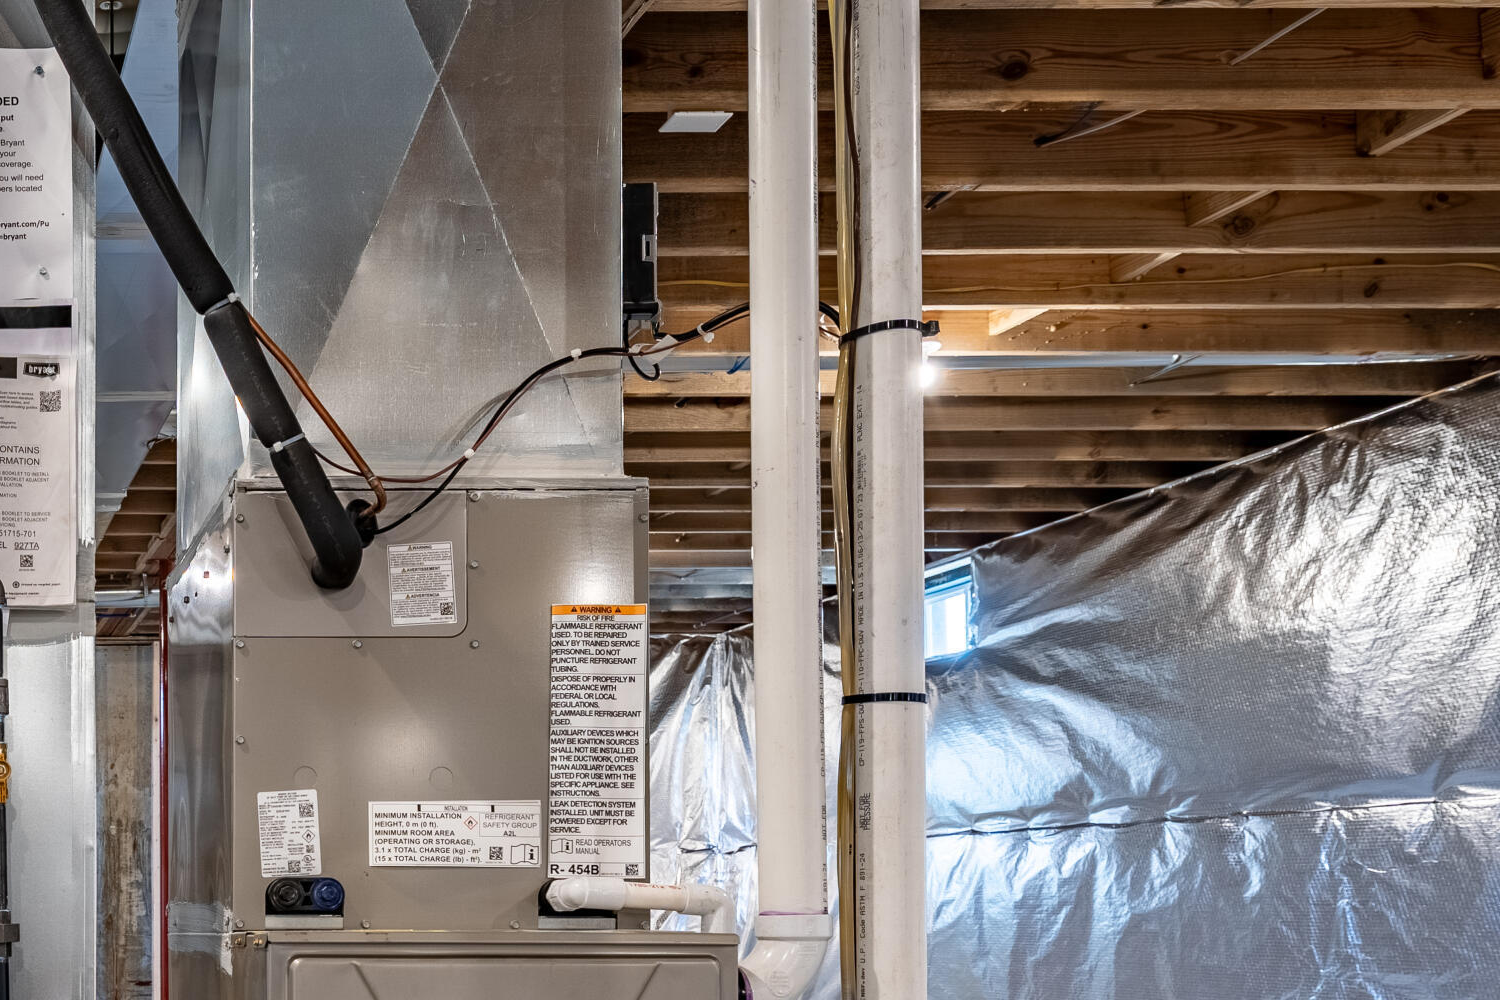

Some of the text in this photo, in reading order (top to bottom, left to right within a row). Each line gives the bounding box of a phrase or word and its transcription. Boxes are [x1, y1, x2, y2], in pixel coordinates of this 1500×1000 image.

[0, 114, 14, 123] put
[0, 139, 25, 148] Bryant
[28, 365, 56, 375] bryat
[14, 542, 40, 551] 927TA
[591, 614, 600, 622] OF
[551, 631, 573, 639] USED.
[550, 864, 599, 875] R- 454B
